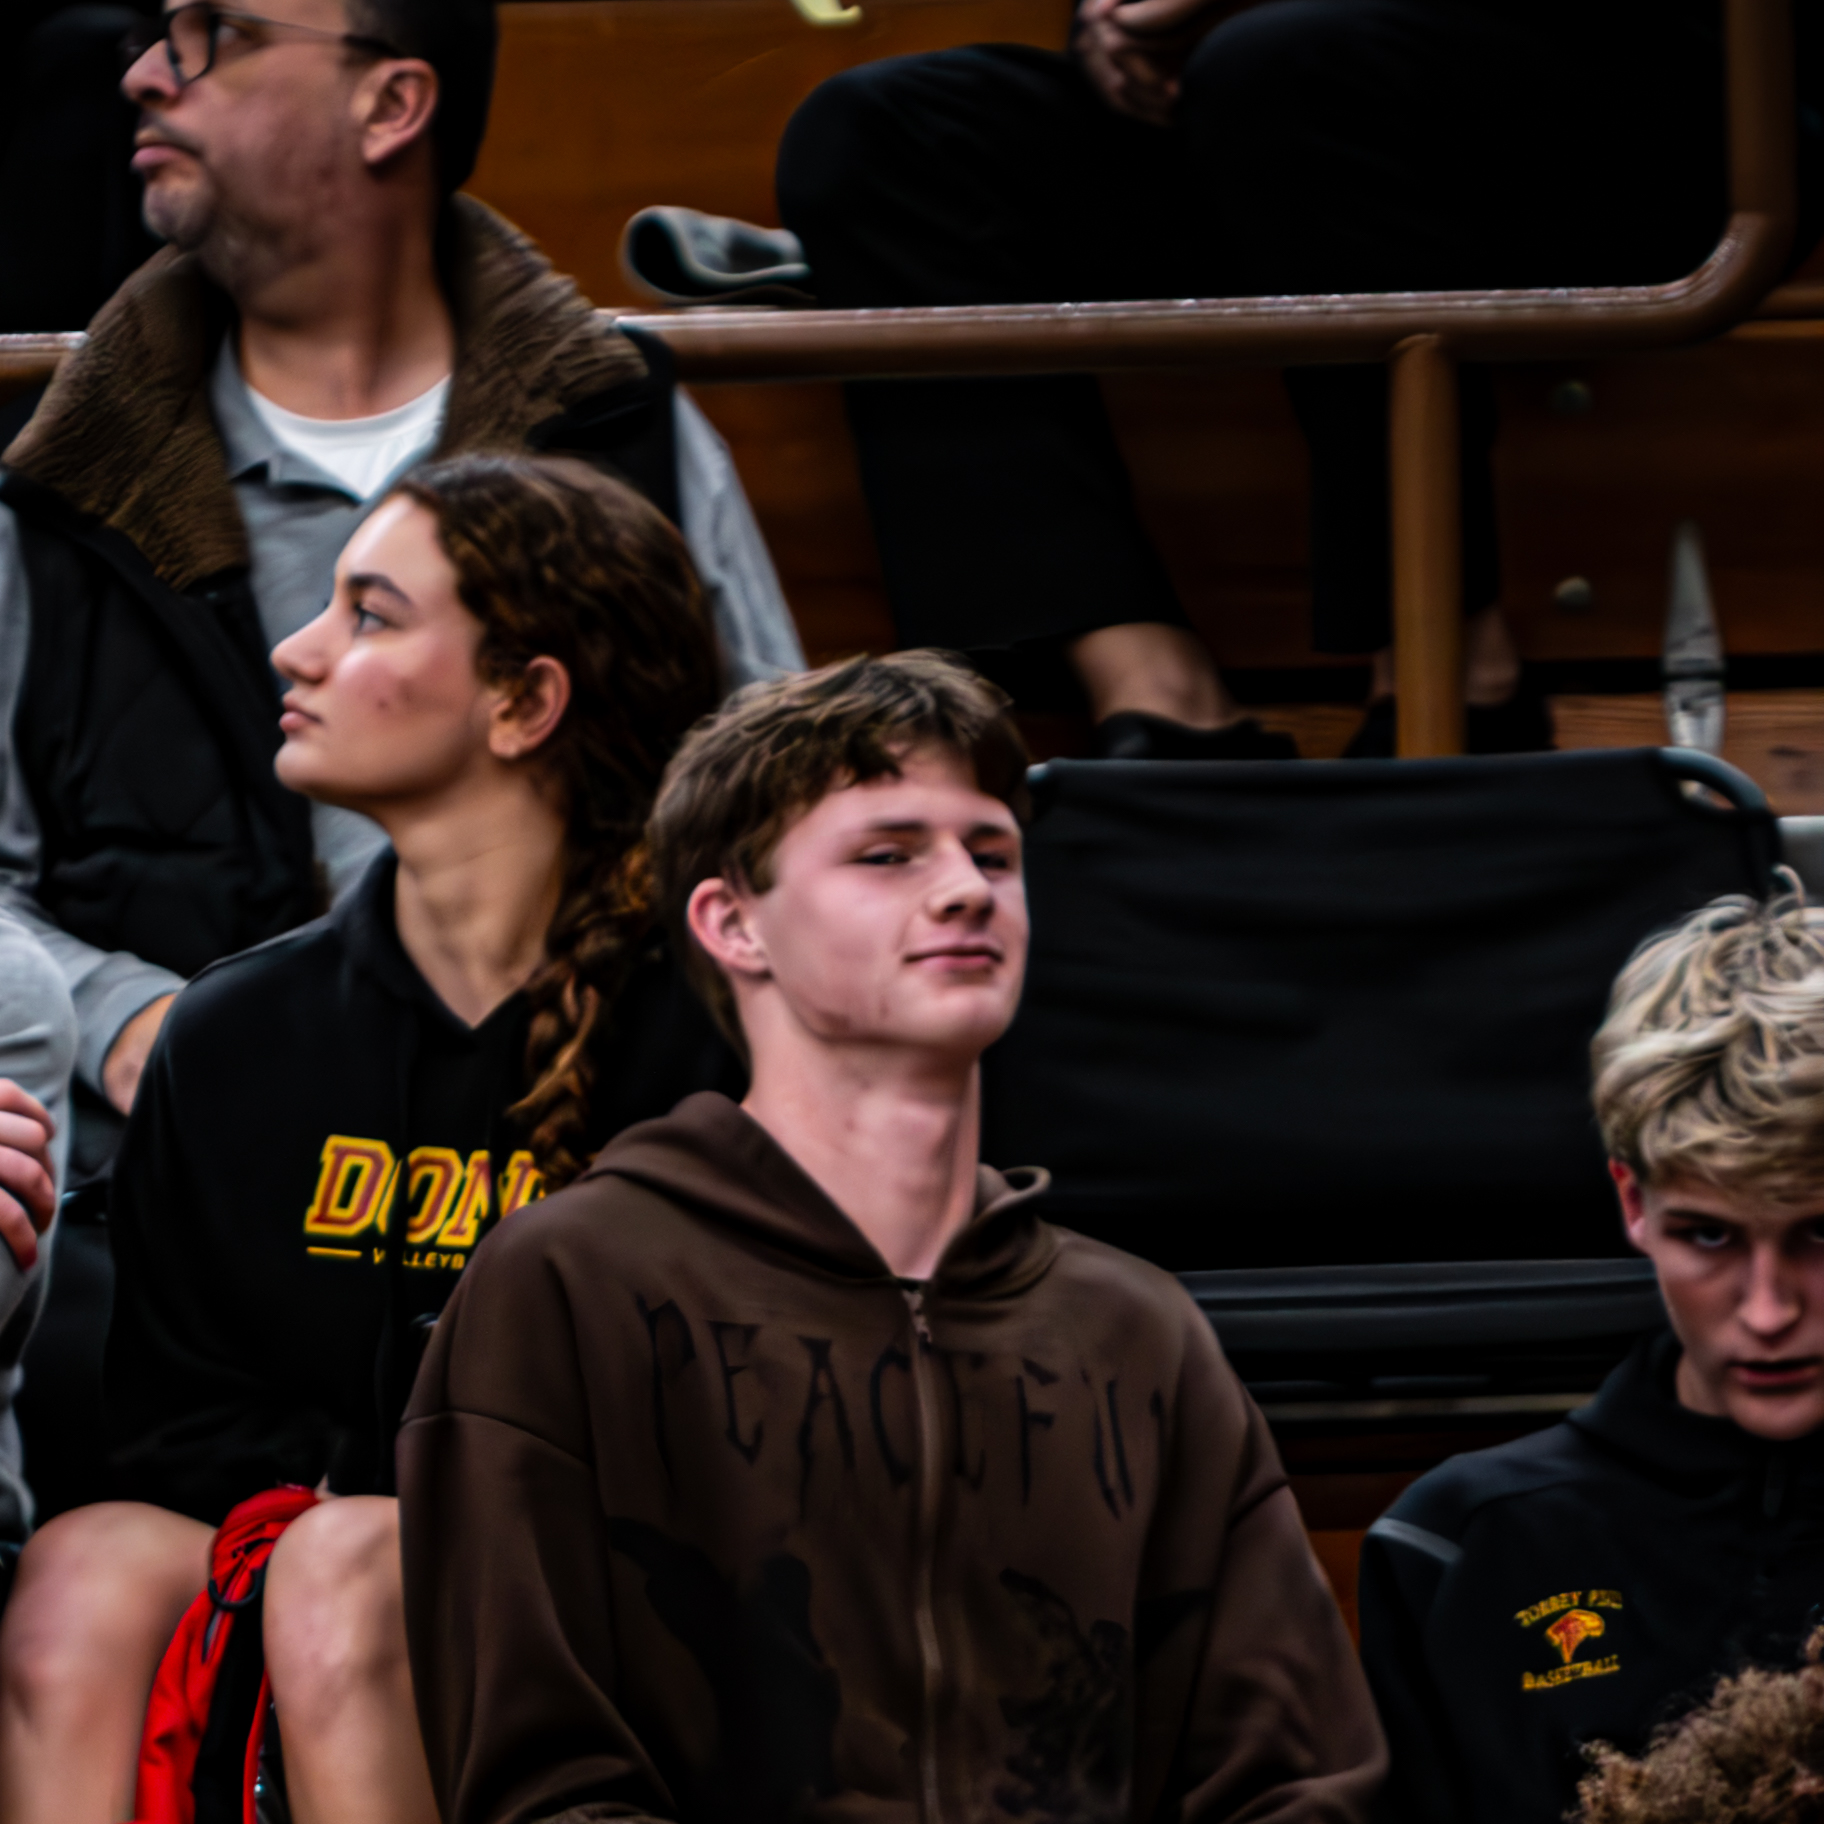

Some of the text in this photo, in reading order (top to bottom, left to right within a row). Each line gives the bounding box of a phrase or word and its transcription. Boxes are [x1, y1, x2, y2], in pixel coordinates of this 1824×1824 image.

[303, 1133, 546, 1247] DON
[635, 1291, 1168, 1525] PEACEFU
[1514, 1590, 1582, 1627] TORREY
[1522, 1653, 1621, 1691] BASKETBALL
